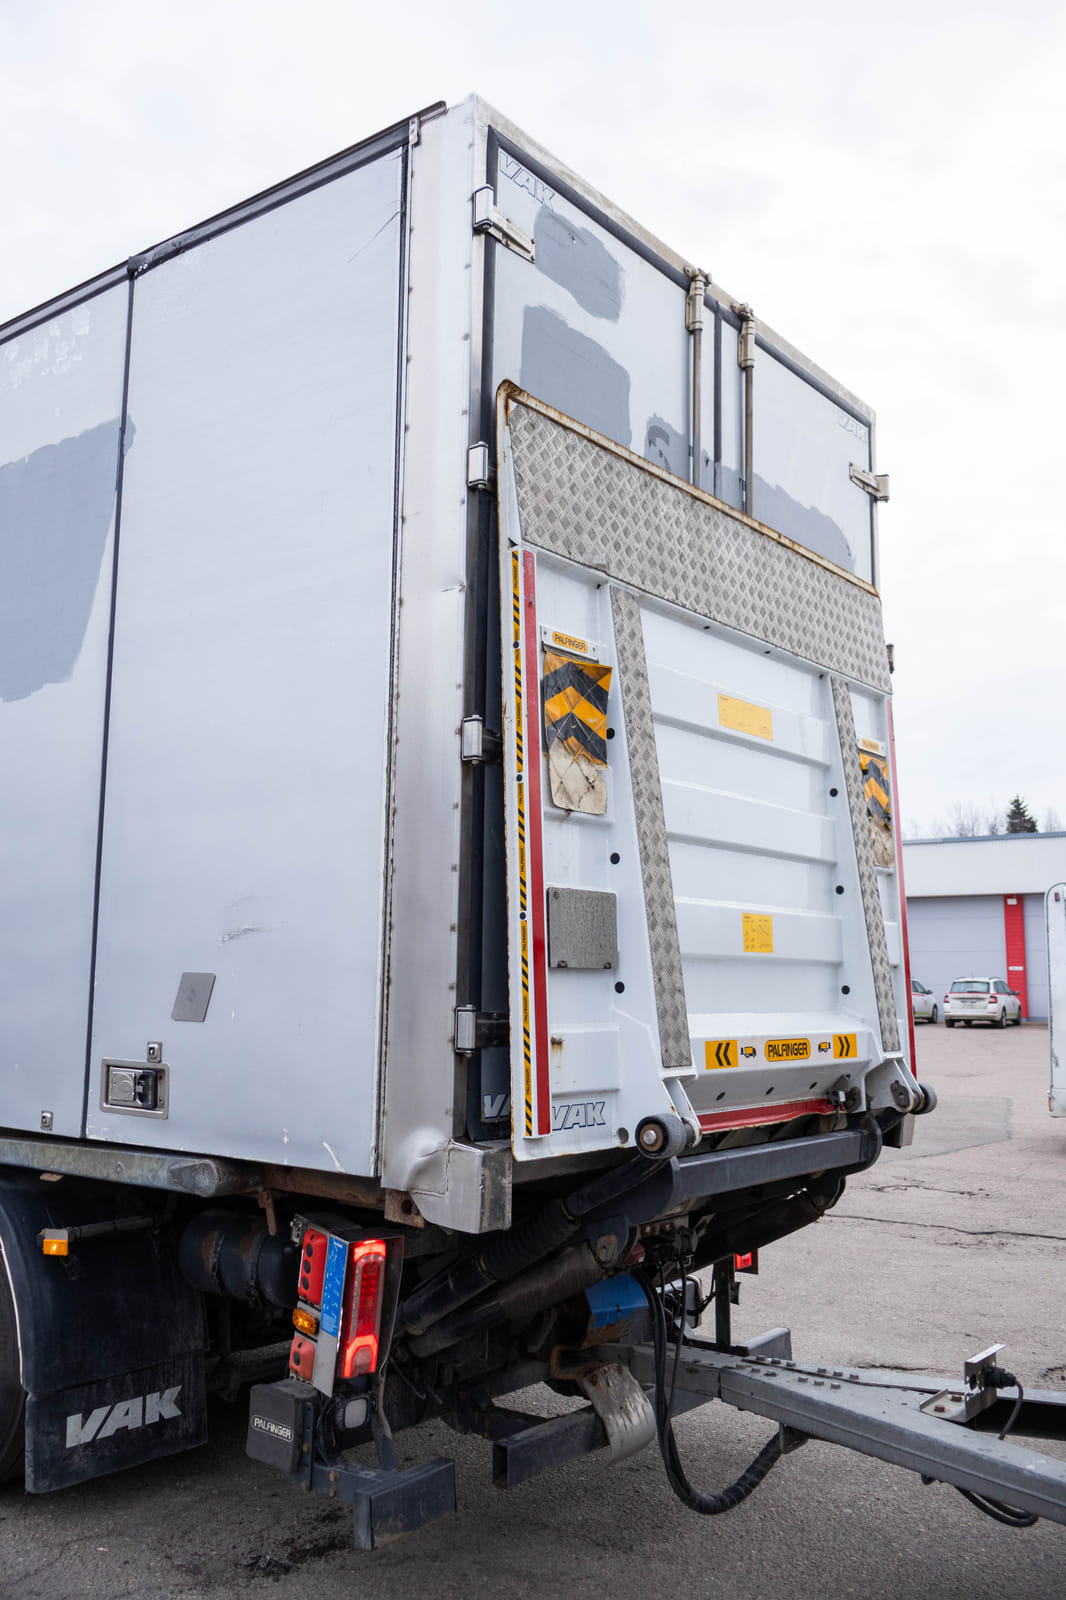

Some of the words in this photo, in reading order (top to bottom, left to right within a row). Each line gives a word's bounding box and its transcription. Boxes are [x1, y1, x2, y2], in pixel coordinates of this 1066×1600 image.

[499, 150, 555, 206] VAK
[554, 633, 586, 651] PALFINGER
[767, 1042, 809, 1058] PALFINGER
[551, 1101, 606, 1131] VAK
[65, 1385, 182, 1449] VAK
[254, 1417, 292, 1440] PALFINGER
